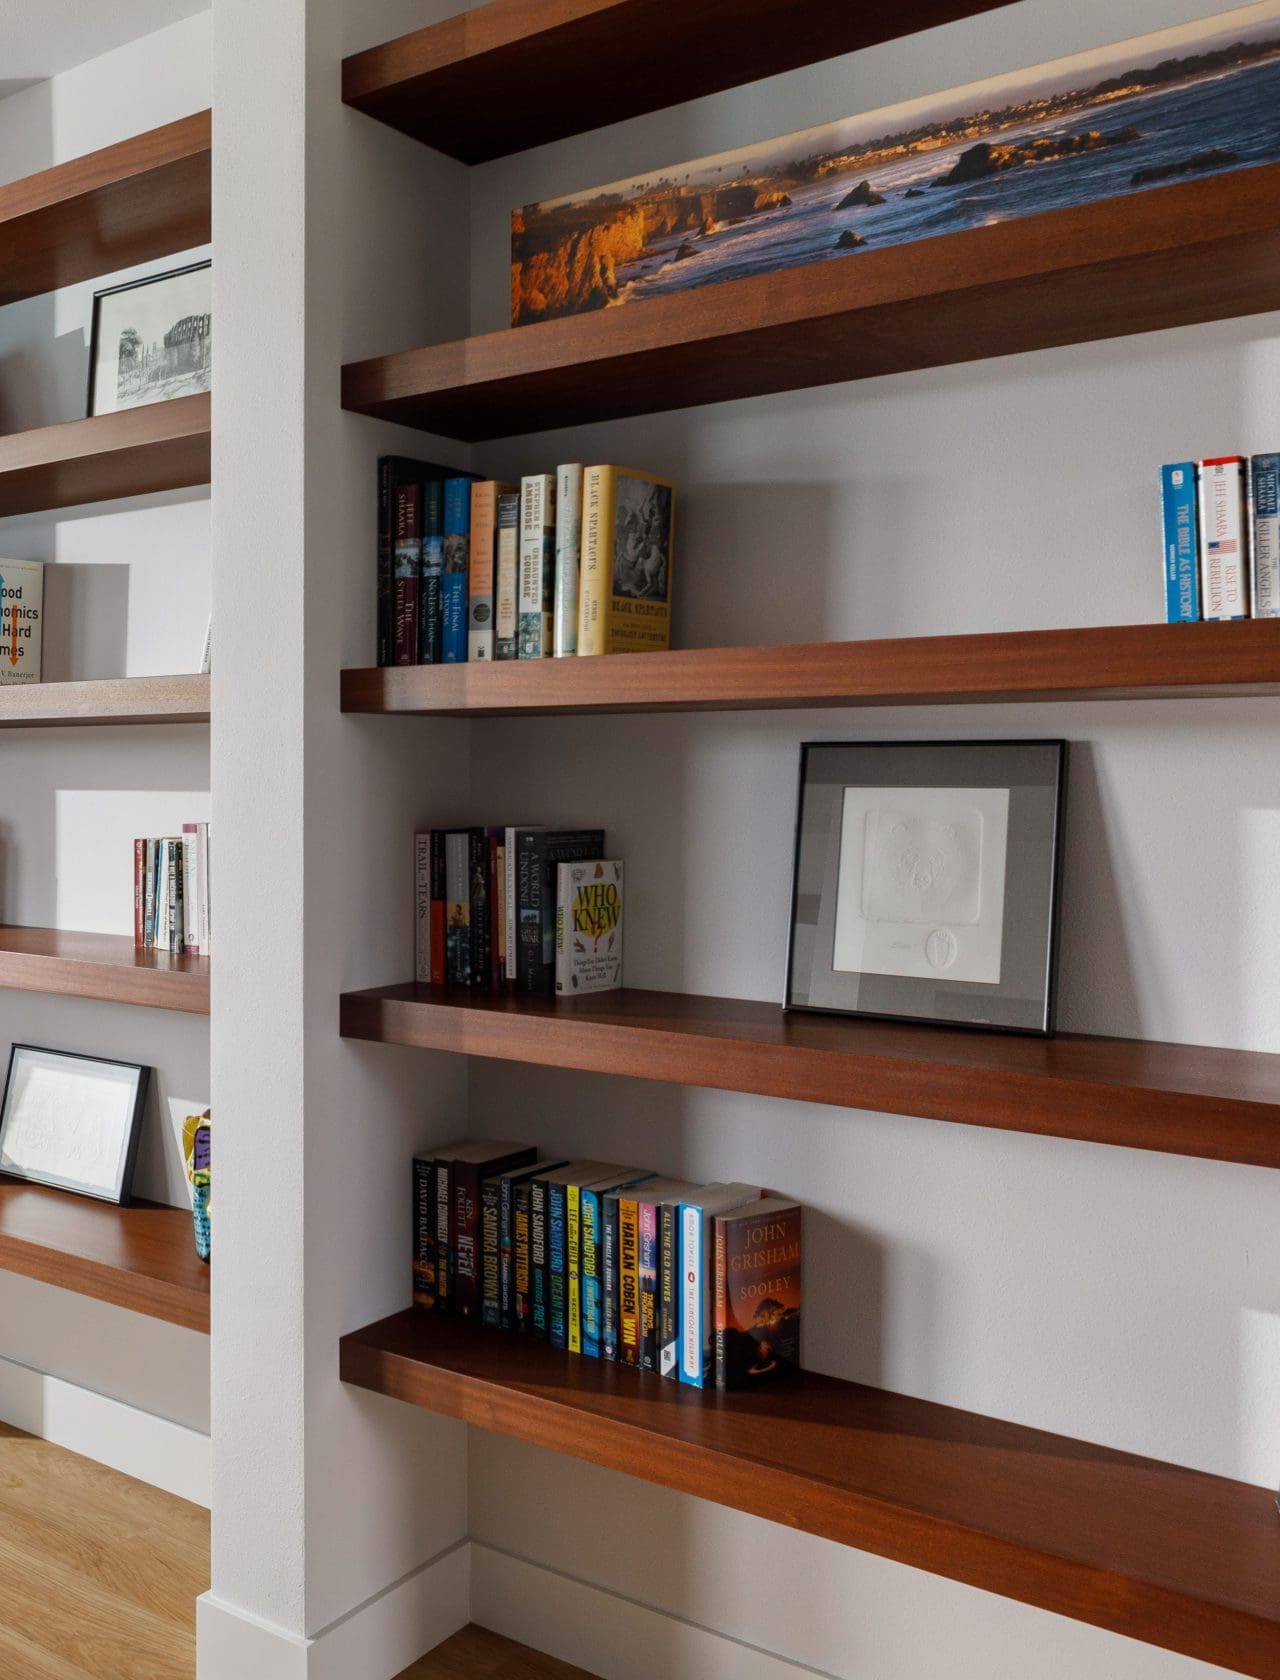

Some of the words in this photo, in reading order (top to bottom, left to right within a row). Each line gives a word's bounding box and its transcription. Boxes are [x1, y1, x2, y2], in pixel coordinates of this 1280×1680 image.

[590, 474, 600, 508] BLACK
[1214, 480, 1226, 497] JEFF
[1258, 477, 1268, 510] SHAARA
[1266, 474, 1277, 512] MICHAEL
[398, 493, 406, 536] SHAARA
[406, 503, 415, 525] JEFF
[525, 483, 533, 531] AMBROSE
[1177, 504, 1189, 525] THE
[1216, 500, 1228, 537] SHAARA
[588, 512, 598, 570] SPARTACUS
[1178, 528, 1190, 555] BIBLE
[1258, 521, 1271, 561] KILLER
[523, 555, 531, 598] COURAGE
[531, 547, 539, 604] UNDAUNTED
[1179, 558, 1191, 572] AS
[1226, 565, 1237, 585] RISE
[397, 580, 405, 610] STEEL
[428, 579, 437, 592] NO
[453, 584, 461, 604] THE
[1180, 574, 1192, 618] HISTORY
[1209, 559, 1222, 612] REBELLION
[1226, 589, 1237, 602] TO
[1259, 563, 1272, 608] ANGELS
[405, 601, 414, 623] THE
[428, 594, 437, 615] LESS
[451, 606, 461, 632] FINAL
[2, 623, 32, 638] Hard
[396, 614, 406, 644] WAVE
[427, 616, 437, 642] THAN
[418, 839, 427, 874] TRAIL
[531, 852, 538, 861] A
[520, 852, 529, 906] UNDONE
[530, 863, 539, 907] WORLD
[577, 883, 618, 908] WHO
[418, 883, 427, 919] TEARS
[419, 1178, 429, 1215] DAVID
[437, 1167, 448, 1202] MICHAEL
[501, 1180, 509, 1201] John
[532, 1184, 543, 1212] JOHN
[457, 1187, 466, 1228] FOLLETT
[465, 1199, 473, 1219] KEN
[501, 1202, 509, 1236] Grisham
[550, 1189, 562, 1217] JOHN
[568, 1209, 578, 1222] LEE
[583, 1200, 595, 1226] JOHN
[643, 1208, 651, 1231] John
[437, 1203, 448, 1244] CONNELLY
[483, 1206, 498, 1252] SANDRA
[516, 1211, 528, 1241] JAMES
[663, 1211, 671, 1229] ALL
[744, 1222, 787, 1250] JOHN
[418, 1217, 430, 1272] BALDACCI
[532, 1213, 544, 1265] SANDFORD
[550, 1219, 563, 1273] SANDFORD
[569, 1240, 579, 1265] CHILD
[583, 1227, 597, 1276] SANDFORD
[623, 1222, 635, 1270] HARLAN
[643, 1232, 653, 1268] Grisham
[716, 1235, 724, 1260] JOHN
[457, 1235, 474, 1278] NEVER
[516, 1242, 529, 1294] PATTERSON
[731, 1241, 800, 1272] GRISHAM
[483, 1255, 498, 1298] BROWN
[551, 1275, 562, 1307] OCEAN
[663, 1269, 671, 1303] KNIVES
[716, 1263, 724, 1309] GRISHAM
[740, 1275, 791, 1300] SOOLEY
[586, 1286, 596, 1333] INVESTIGATOR
[623, 1275, 635, 1314] COBEN
[533, 1304, 545, 1329] PREY
[552, 1310, 563, 1336] PREY
[624, 1318, 636, 1345] WIN
[716, 1322, 724, 1363] SOOLEY
